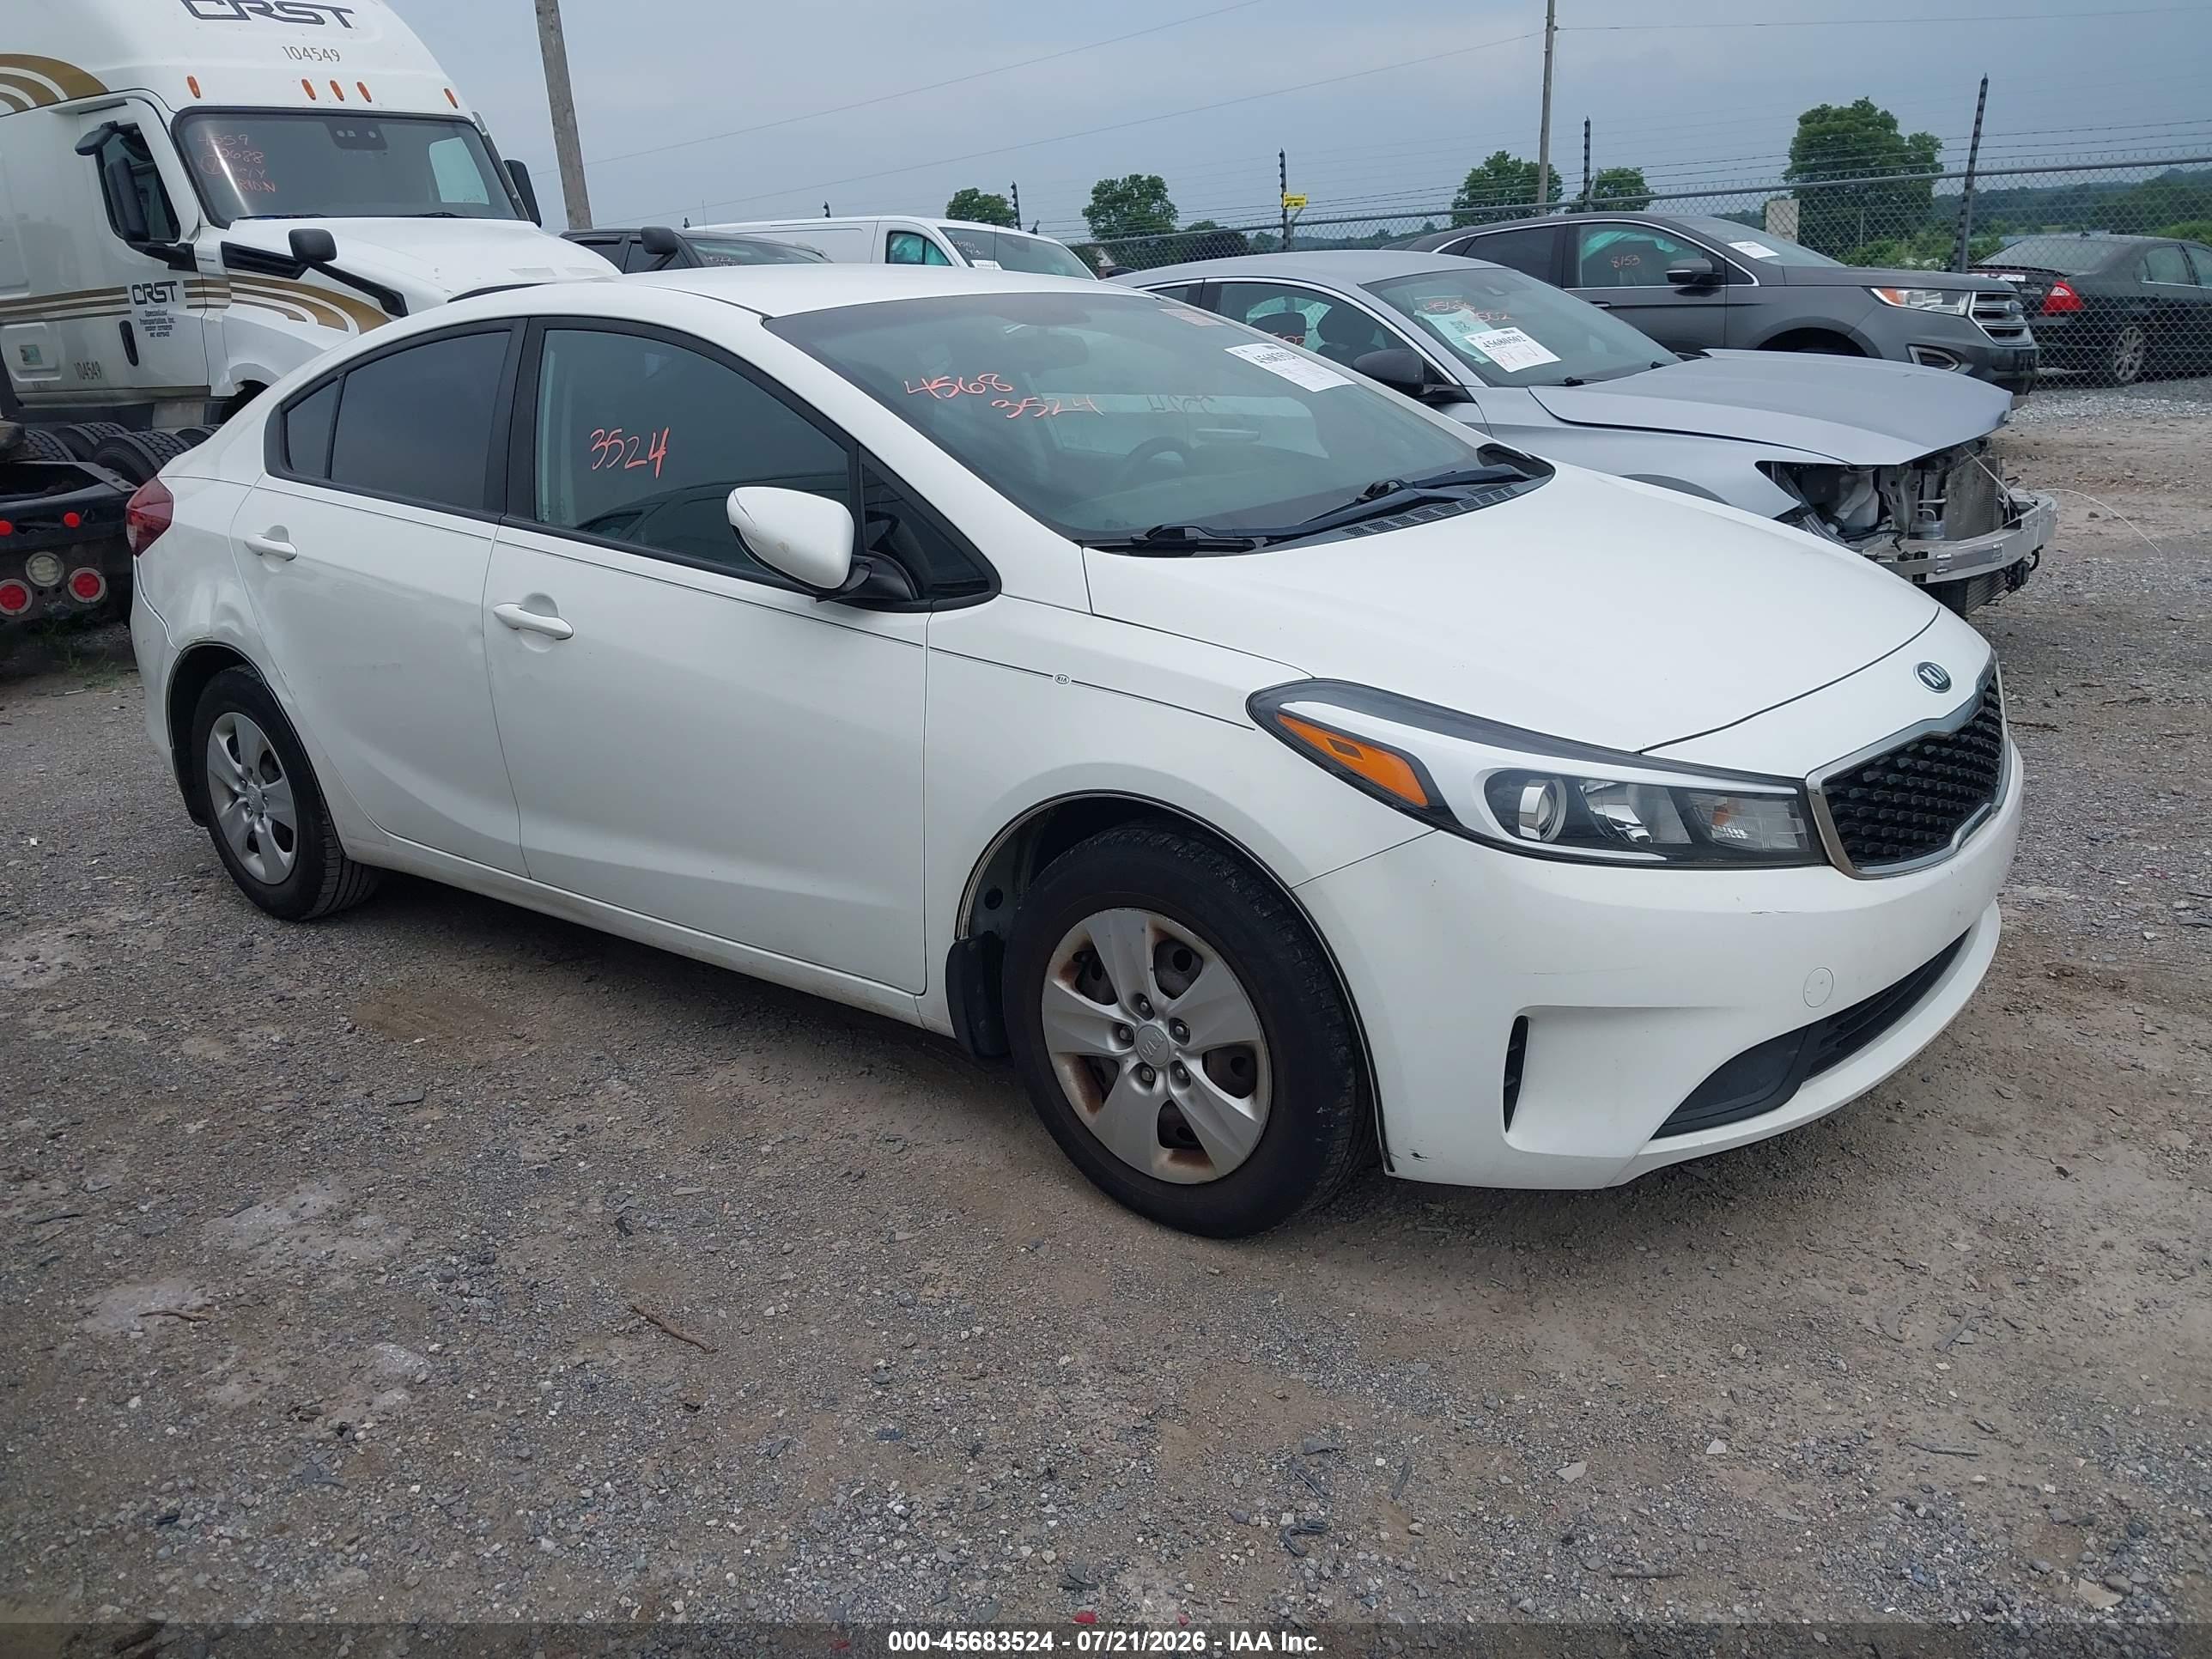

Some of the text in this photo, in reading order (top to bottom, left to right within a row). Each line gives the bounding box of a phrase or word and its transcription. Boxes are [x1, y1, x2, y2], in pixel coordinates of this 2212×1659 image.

[180, 0, 355, 29] CRST
[282, 46, 340, 63] 104549
[131, 280, 178, 305] CRST
[904, 374, 1013, 399] 4568
[991, 394, 1105, 418] 3524
[590, 426, 670, 479] 3524
